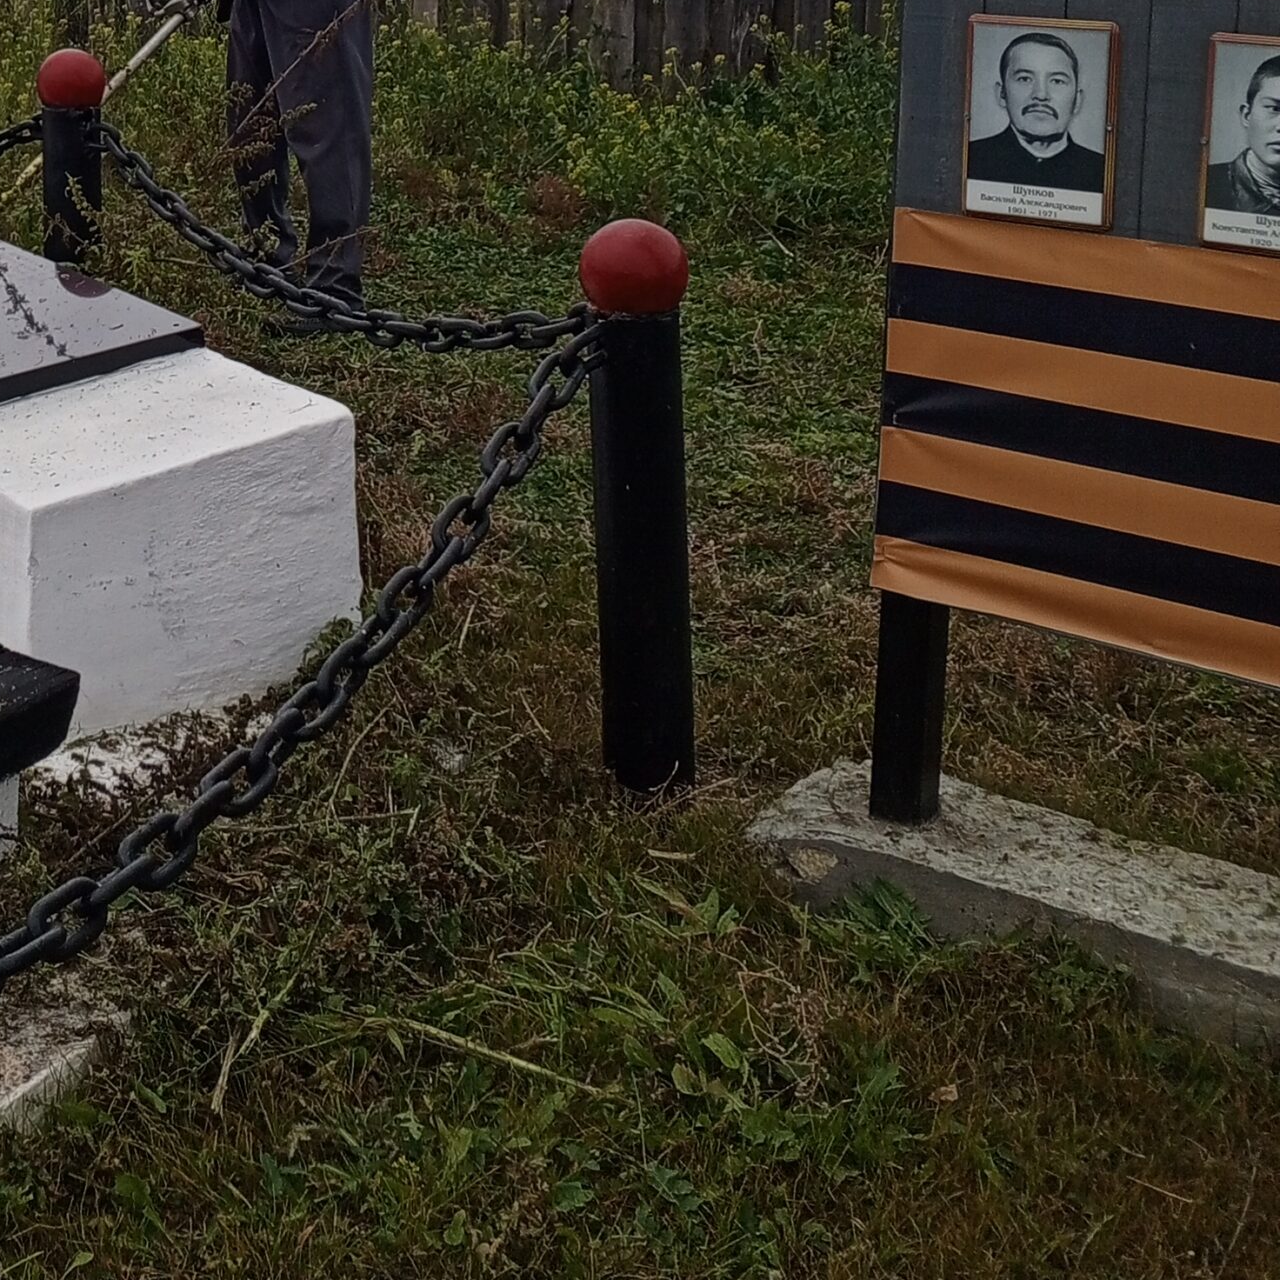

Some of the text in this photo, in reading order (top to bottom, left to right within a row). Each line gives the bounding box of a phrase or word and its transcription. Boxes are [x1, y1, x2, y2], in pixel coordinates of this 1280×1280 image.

[1012, 185, 1055, 198] Шунков
[980, 192, 1088, 212] Василий Александрович
